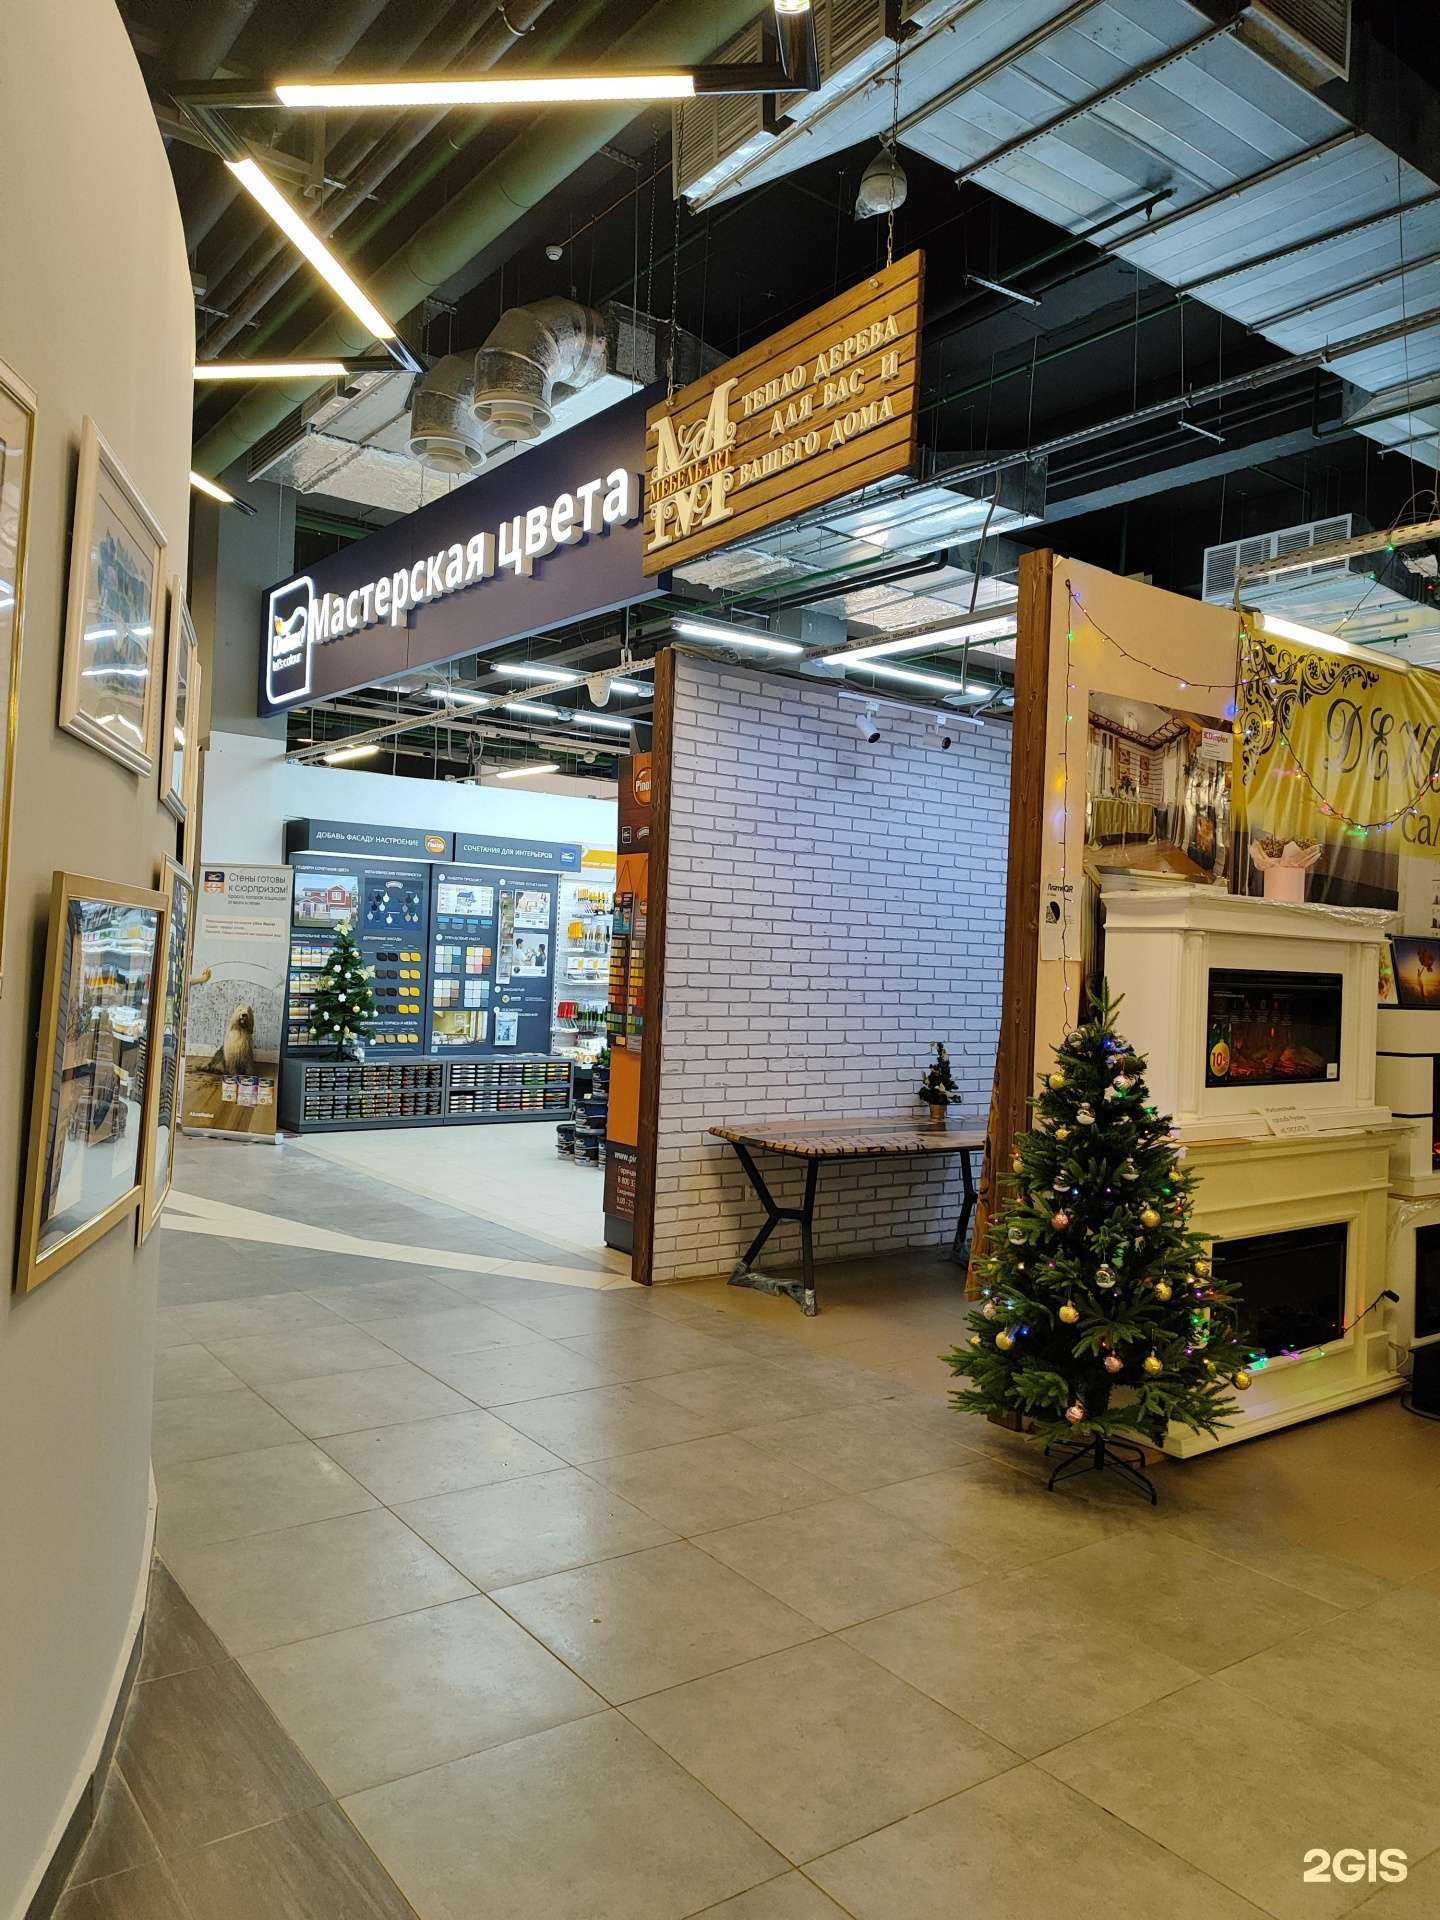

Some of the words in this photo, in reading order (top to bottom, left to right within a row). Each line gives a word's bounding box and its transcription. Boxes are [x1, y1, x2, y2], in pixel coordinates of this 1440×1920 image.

[741, 365, 807, 417] ТЕПЛО
[813, 313, 901, 382] ДЕРЕВА
[768, 393, 814, 439] ДЛЯ
[823, 367, 866, 410] ВАС
[880, 350, 901, 381] И
[739, 430, 822, 486] ВАШЕГО
[827, 395, 896, 451] ДОМА
[649, 460, 704, 505] МЕБЕЛЬ
[309, 530, 492, 643] Мастерская
[497, 466, 636, 576] цвета
[315, 831, 346, 840] ДОБАВЬ
[346, 833, 374, 844] ФАСАДУ
[375, 836, 420, 847] НАСТРОЕНИЕ
[463, 844, 501, 855] СОЧЕТАНИЯ
[500, 847, 514, 856] ДЛЯ
[515, 849, 553, 859] ИНТЕРЬЕРОВ
[228, 872, 256, 883] Стены
[257, 875, 286, 884] готовы
[234, 885, 289, 896] сюрпризам!
